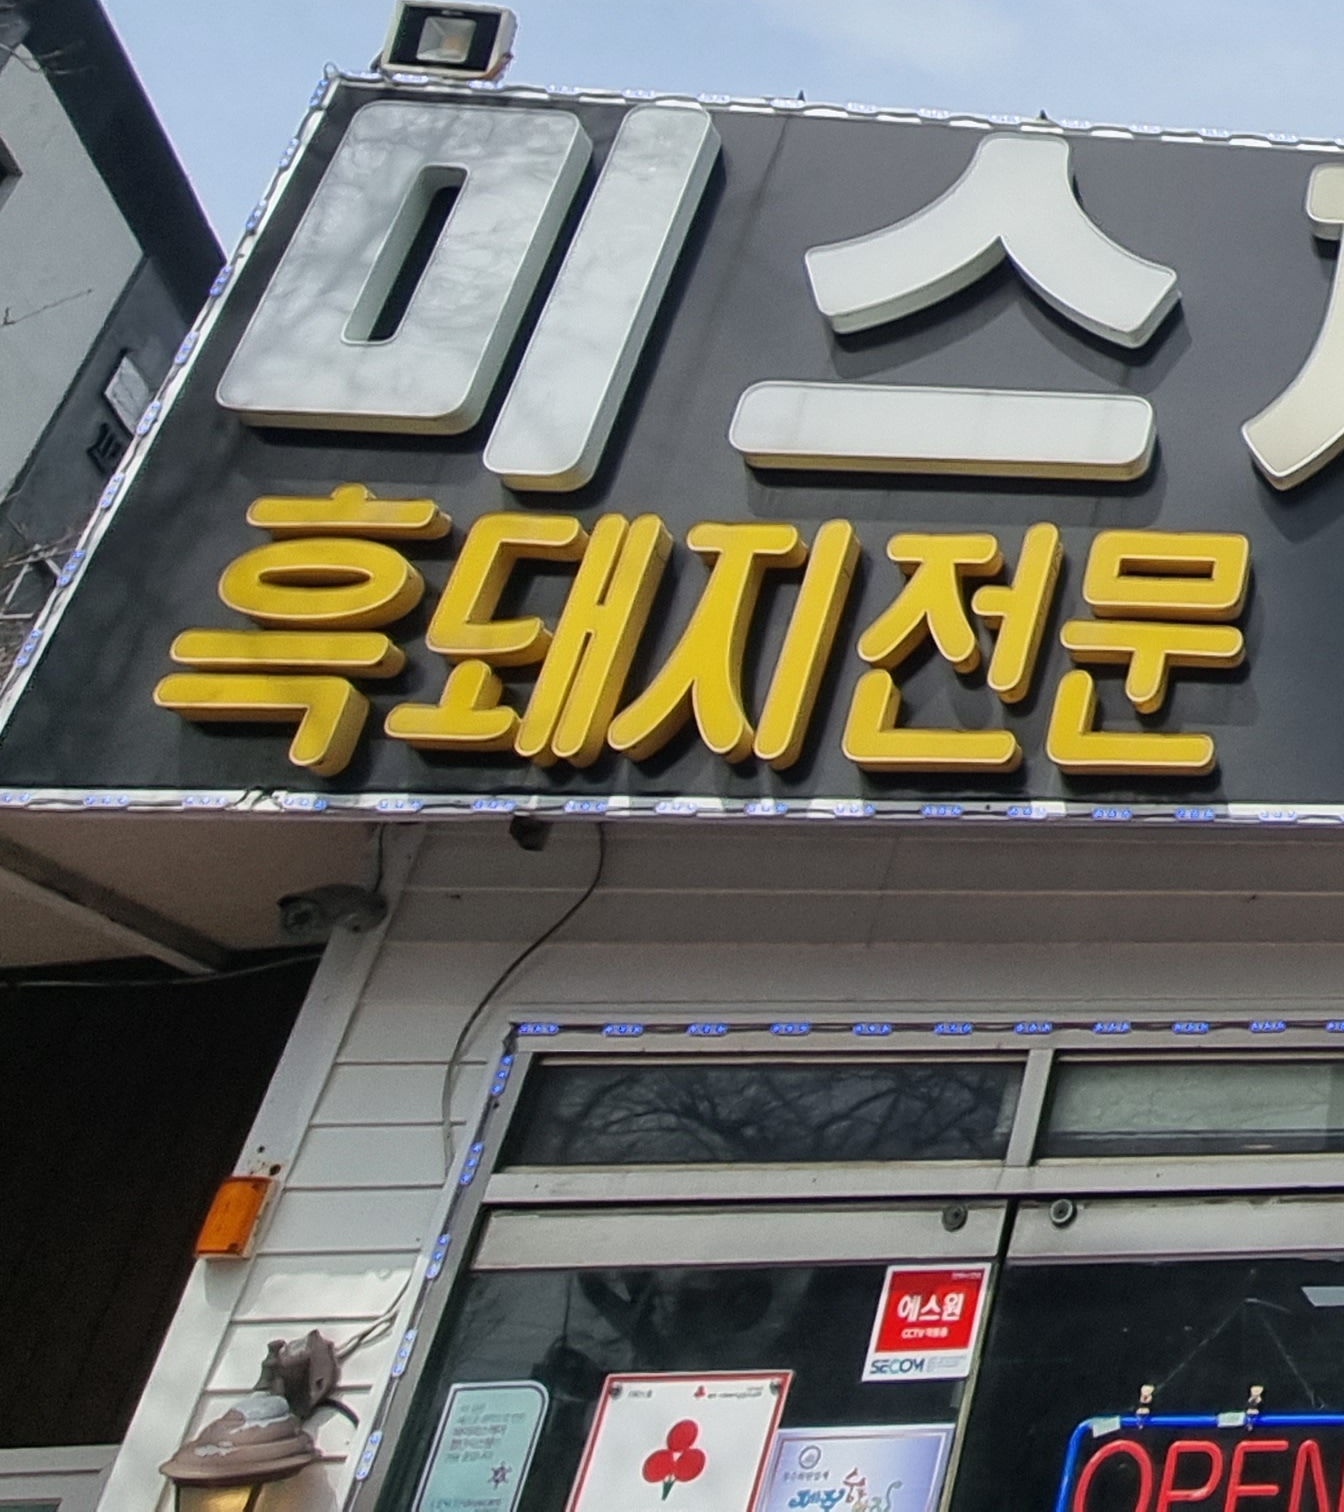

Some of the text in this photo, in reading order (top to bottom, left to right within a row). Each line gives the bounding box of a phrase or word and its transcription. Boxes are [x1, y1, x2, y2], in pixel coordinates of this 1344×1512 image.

[154, 484, 1250, 774] 흑돼지전문
[897, 1293, 965, 1322] 에스원
[870, 1358, 926, 1374] SECOM
